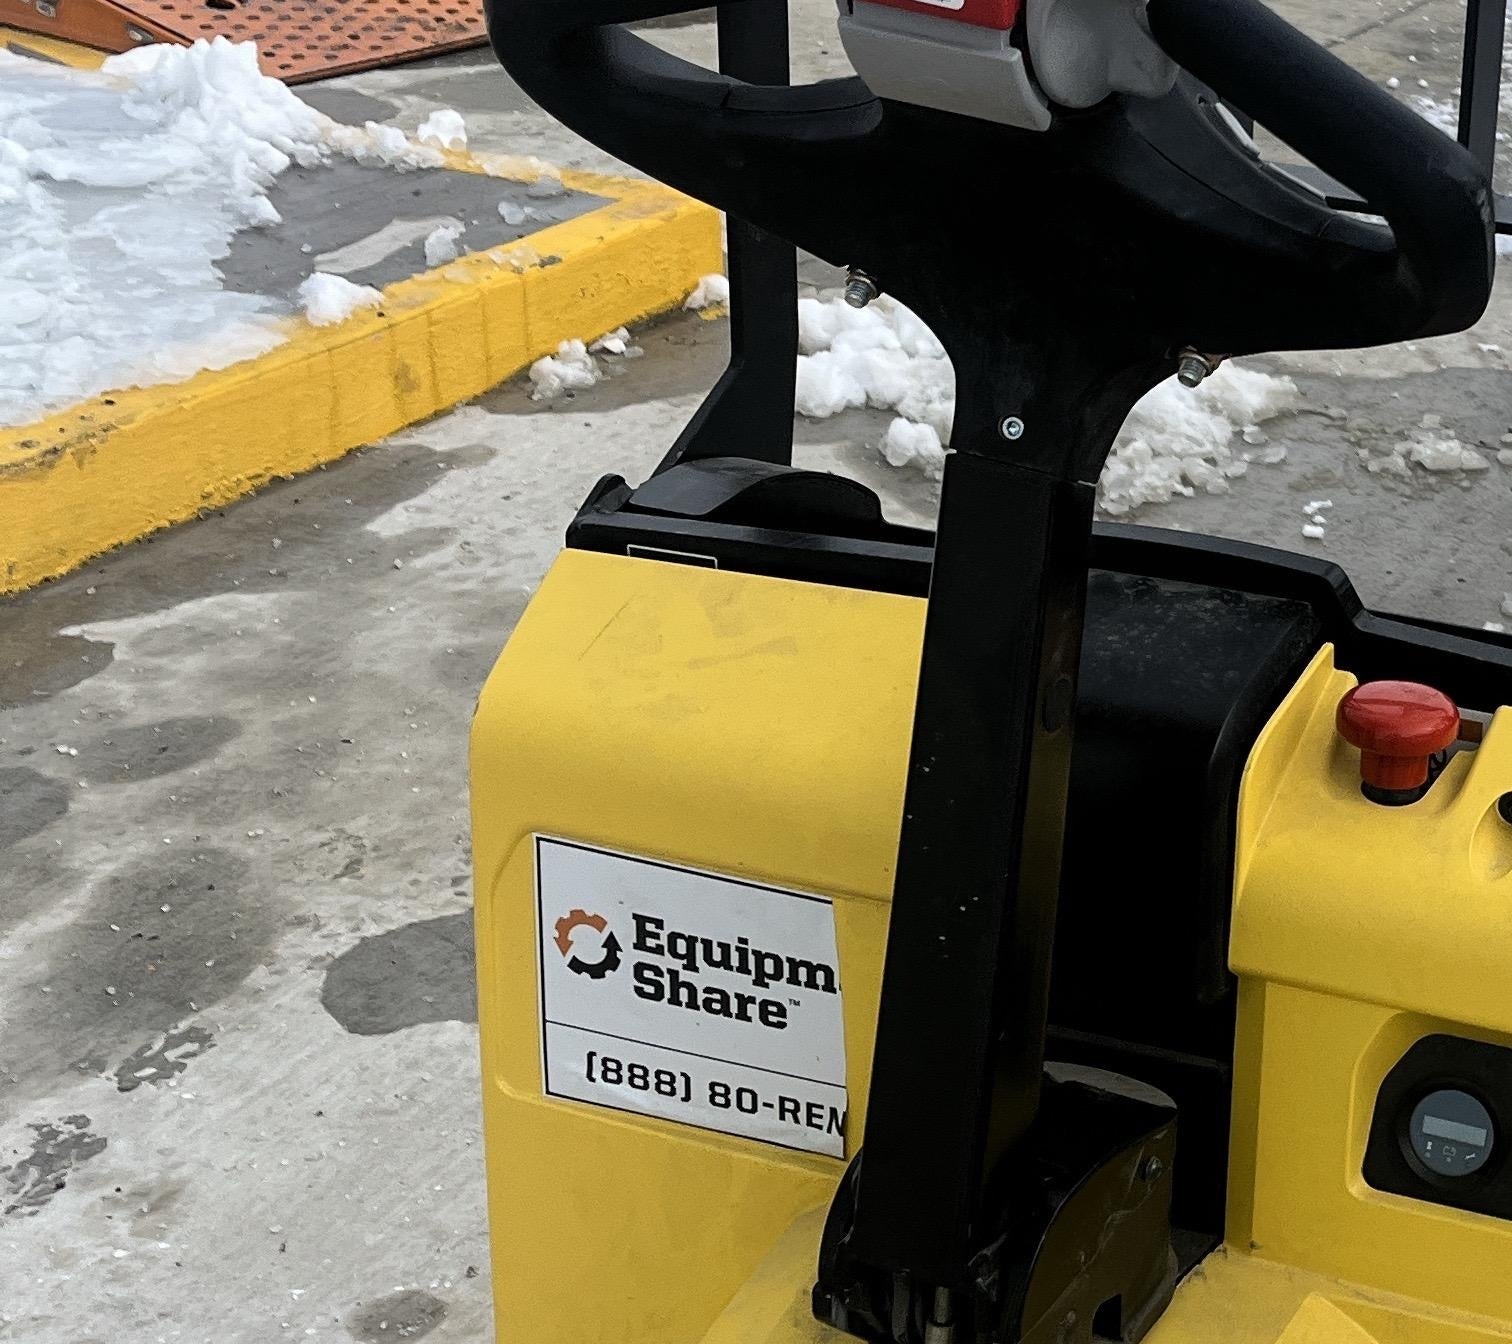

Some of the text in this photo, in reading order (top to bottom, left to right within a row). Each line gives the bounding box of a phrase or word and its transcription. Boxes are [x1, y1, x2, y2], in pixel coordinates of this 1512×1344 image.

[632, 913, 842, 994] Equipm
[632, 961, 788, 1029] Share
[586, 1051, 691, 1102] (888)
